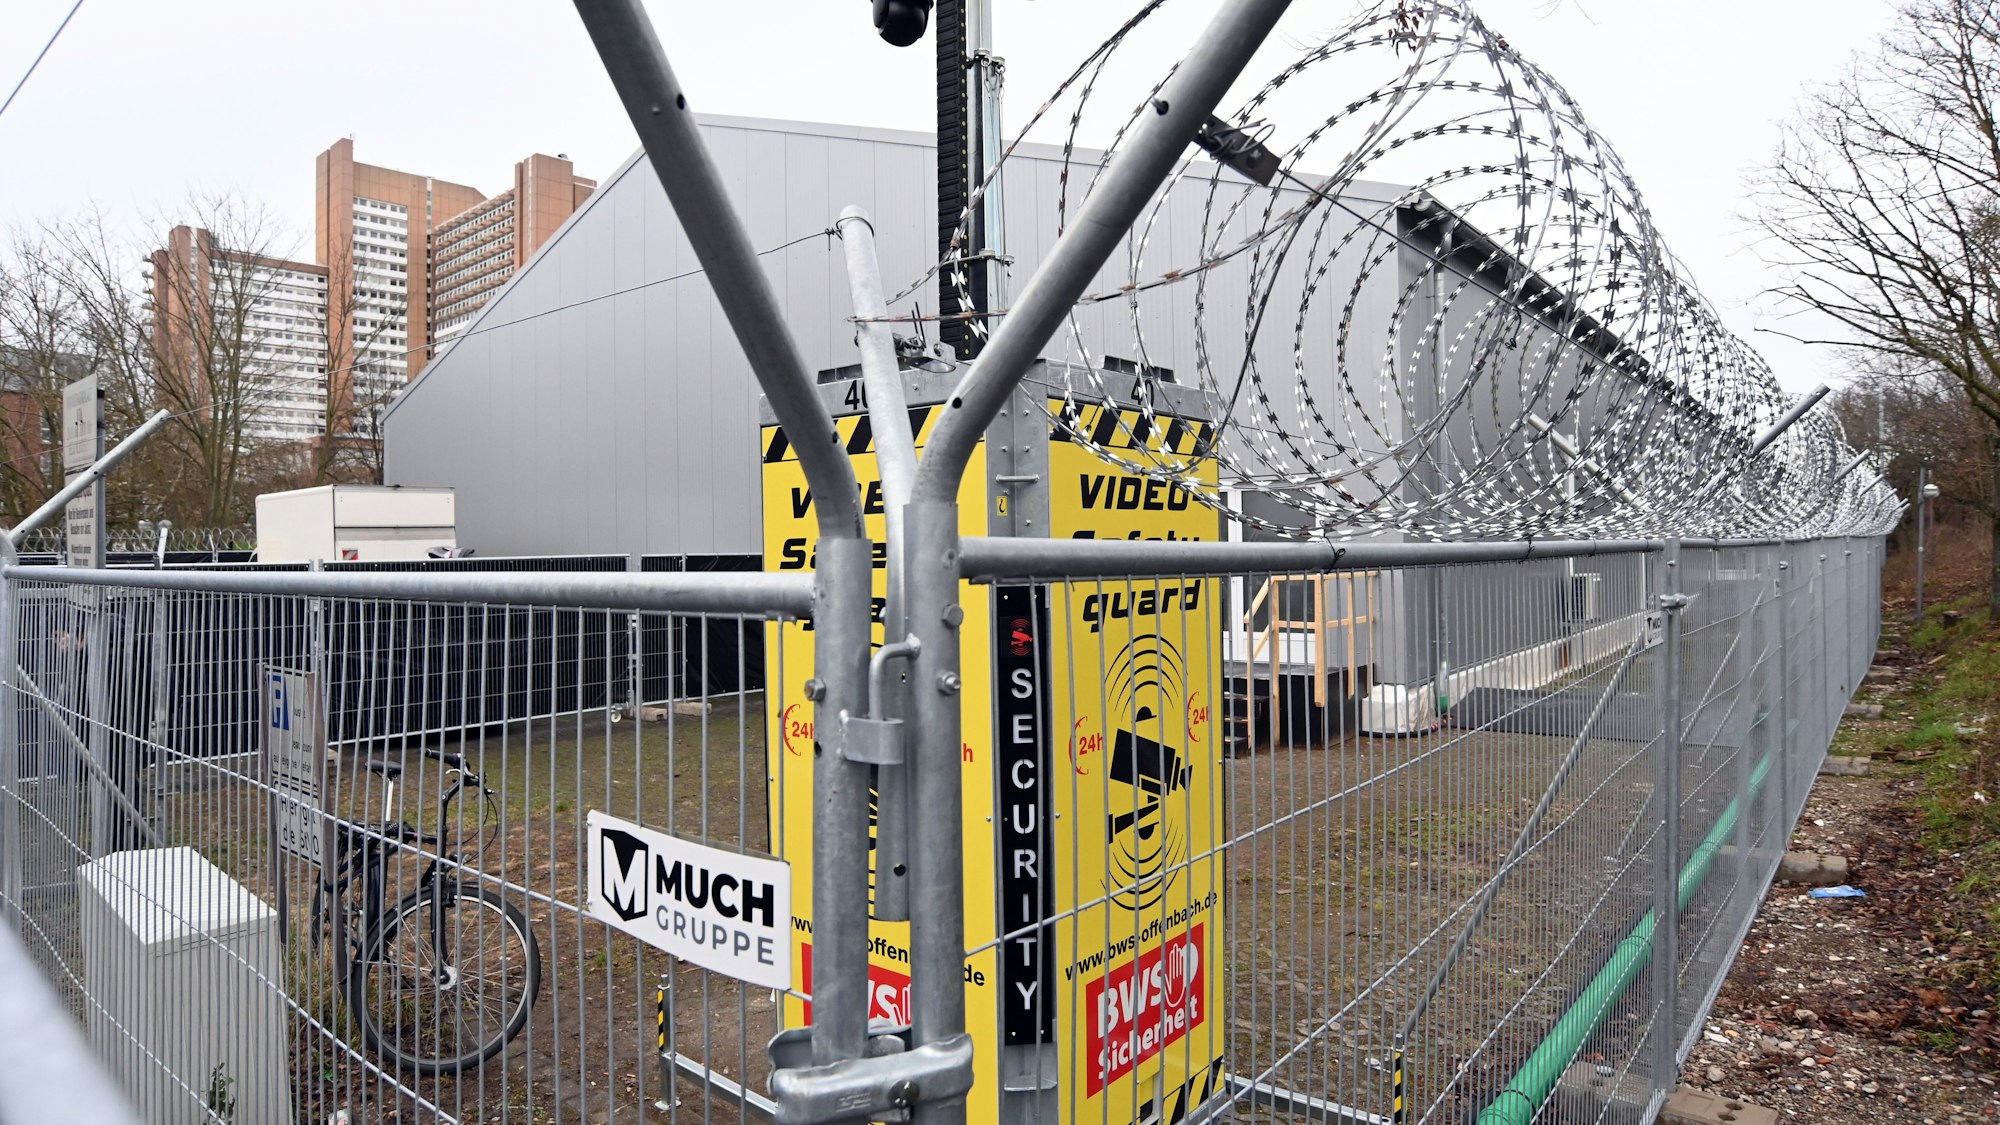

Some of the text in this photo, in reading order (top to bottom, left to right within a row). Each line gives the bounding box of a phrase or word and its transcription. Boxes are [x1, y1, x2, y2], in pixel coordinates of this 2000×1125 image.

[1082, 580, 1201, 633] guard
[281, 797, 298, 816] Her
[283, 823, 296, 845] de
[1010, 667, 1038, 1010] SECURITY
[656, 854, 774, 928] MUCH
[656, 905, 774, 966] GRUPPE
[1097, 959, 1166, 1039] BWS
[1098, 994, 1198, 1080] Sicherhet
